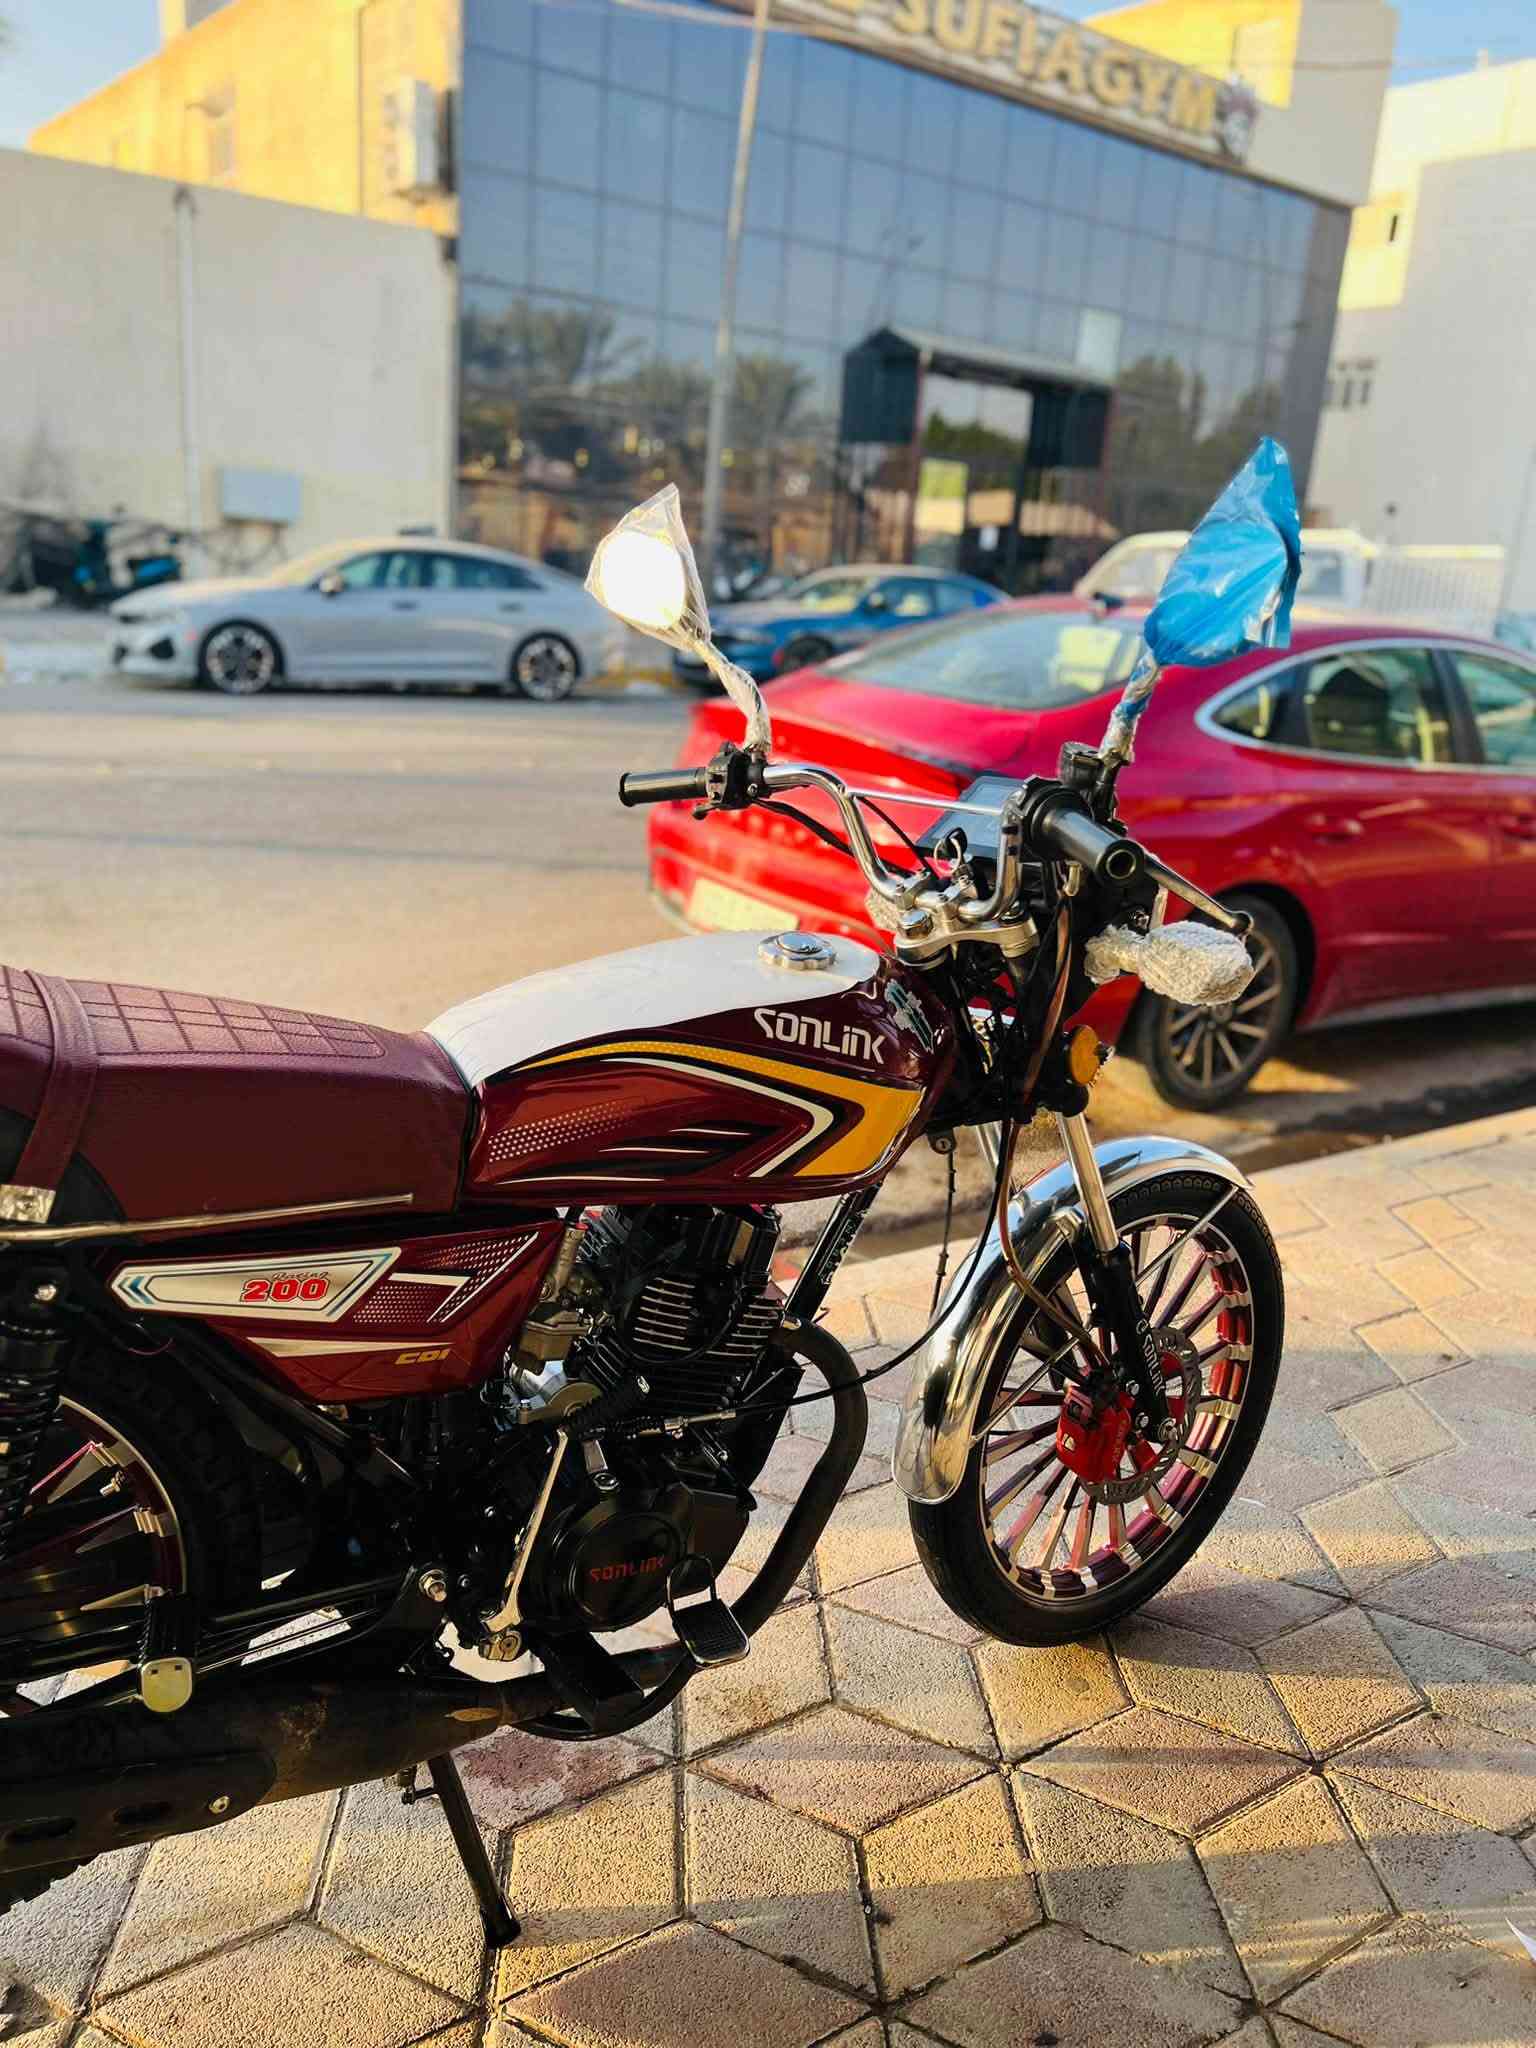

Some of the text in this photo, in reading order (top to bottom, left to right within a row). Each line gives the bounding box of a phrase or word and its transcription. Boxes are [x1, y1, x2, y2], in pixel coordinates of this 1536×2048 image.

[753, 1007, 886, 1064] SONLINK
[240, 1278, 329, 1302] 200
[395, 1348, 451, 1365] CDI
